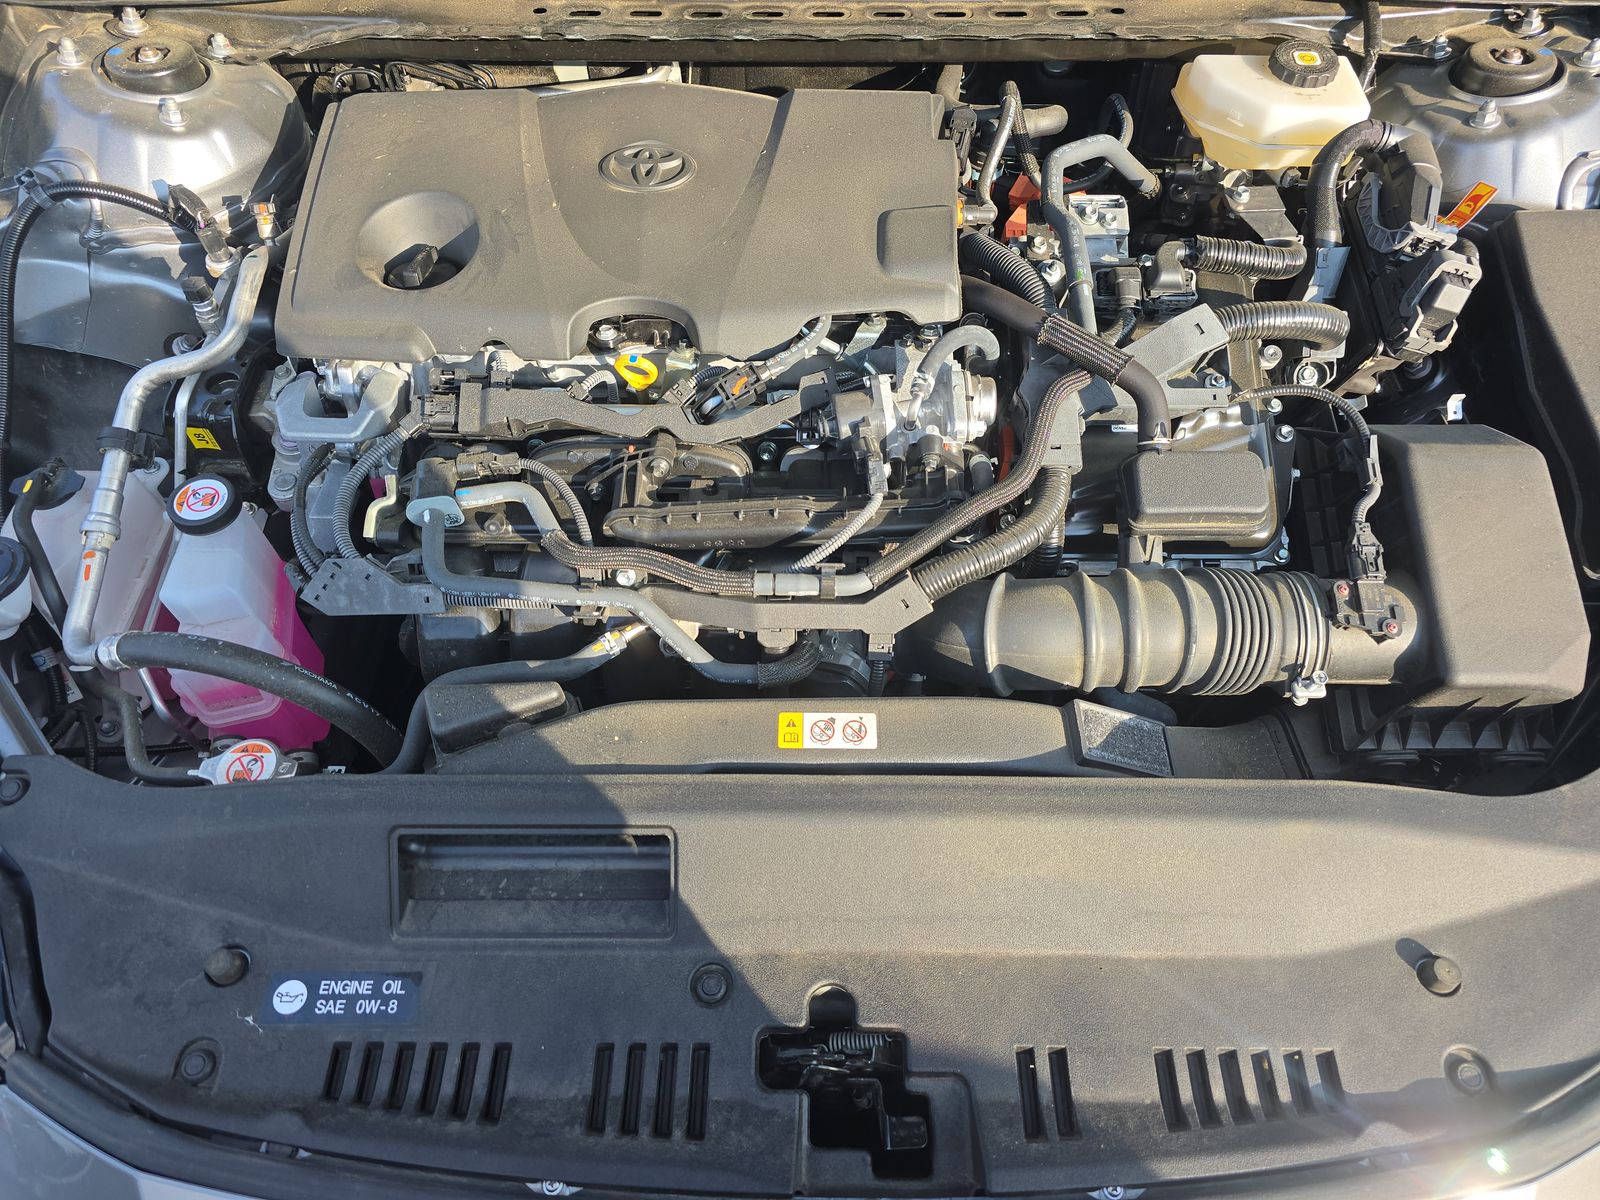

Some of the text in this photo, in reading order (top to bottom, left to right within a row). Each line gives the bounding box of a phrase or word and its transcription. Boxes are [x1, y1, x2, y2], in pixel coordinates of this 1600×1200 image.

[294, 665, 338, 690] YOKOHAMA
[319, 980, 405, 995] ENGINE OIL
[315, 999, 398, 1014] SAE 0W-8
